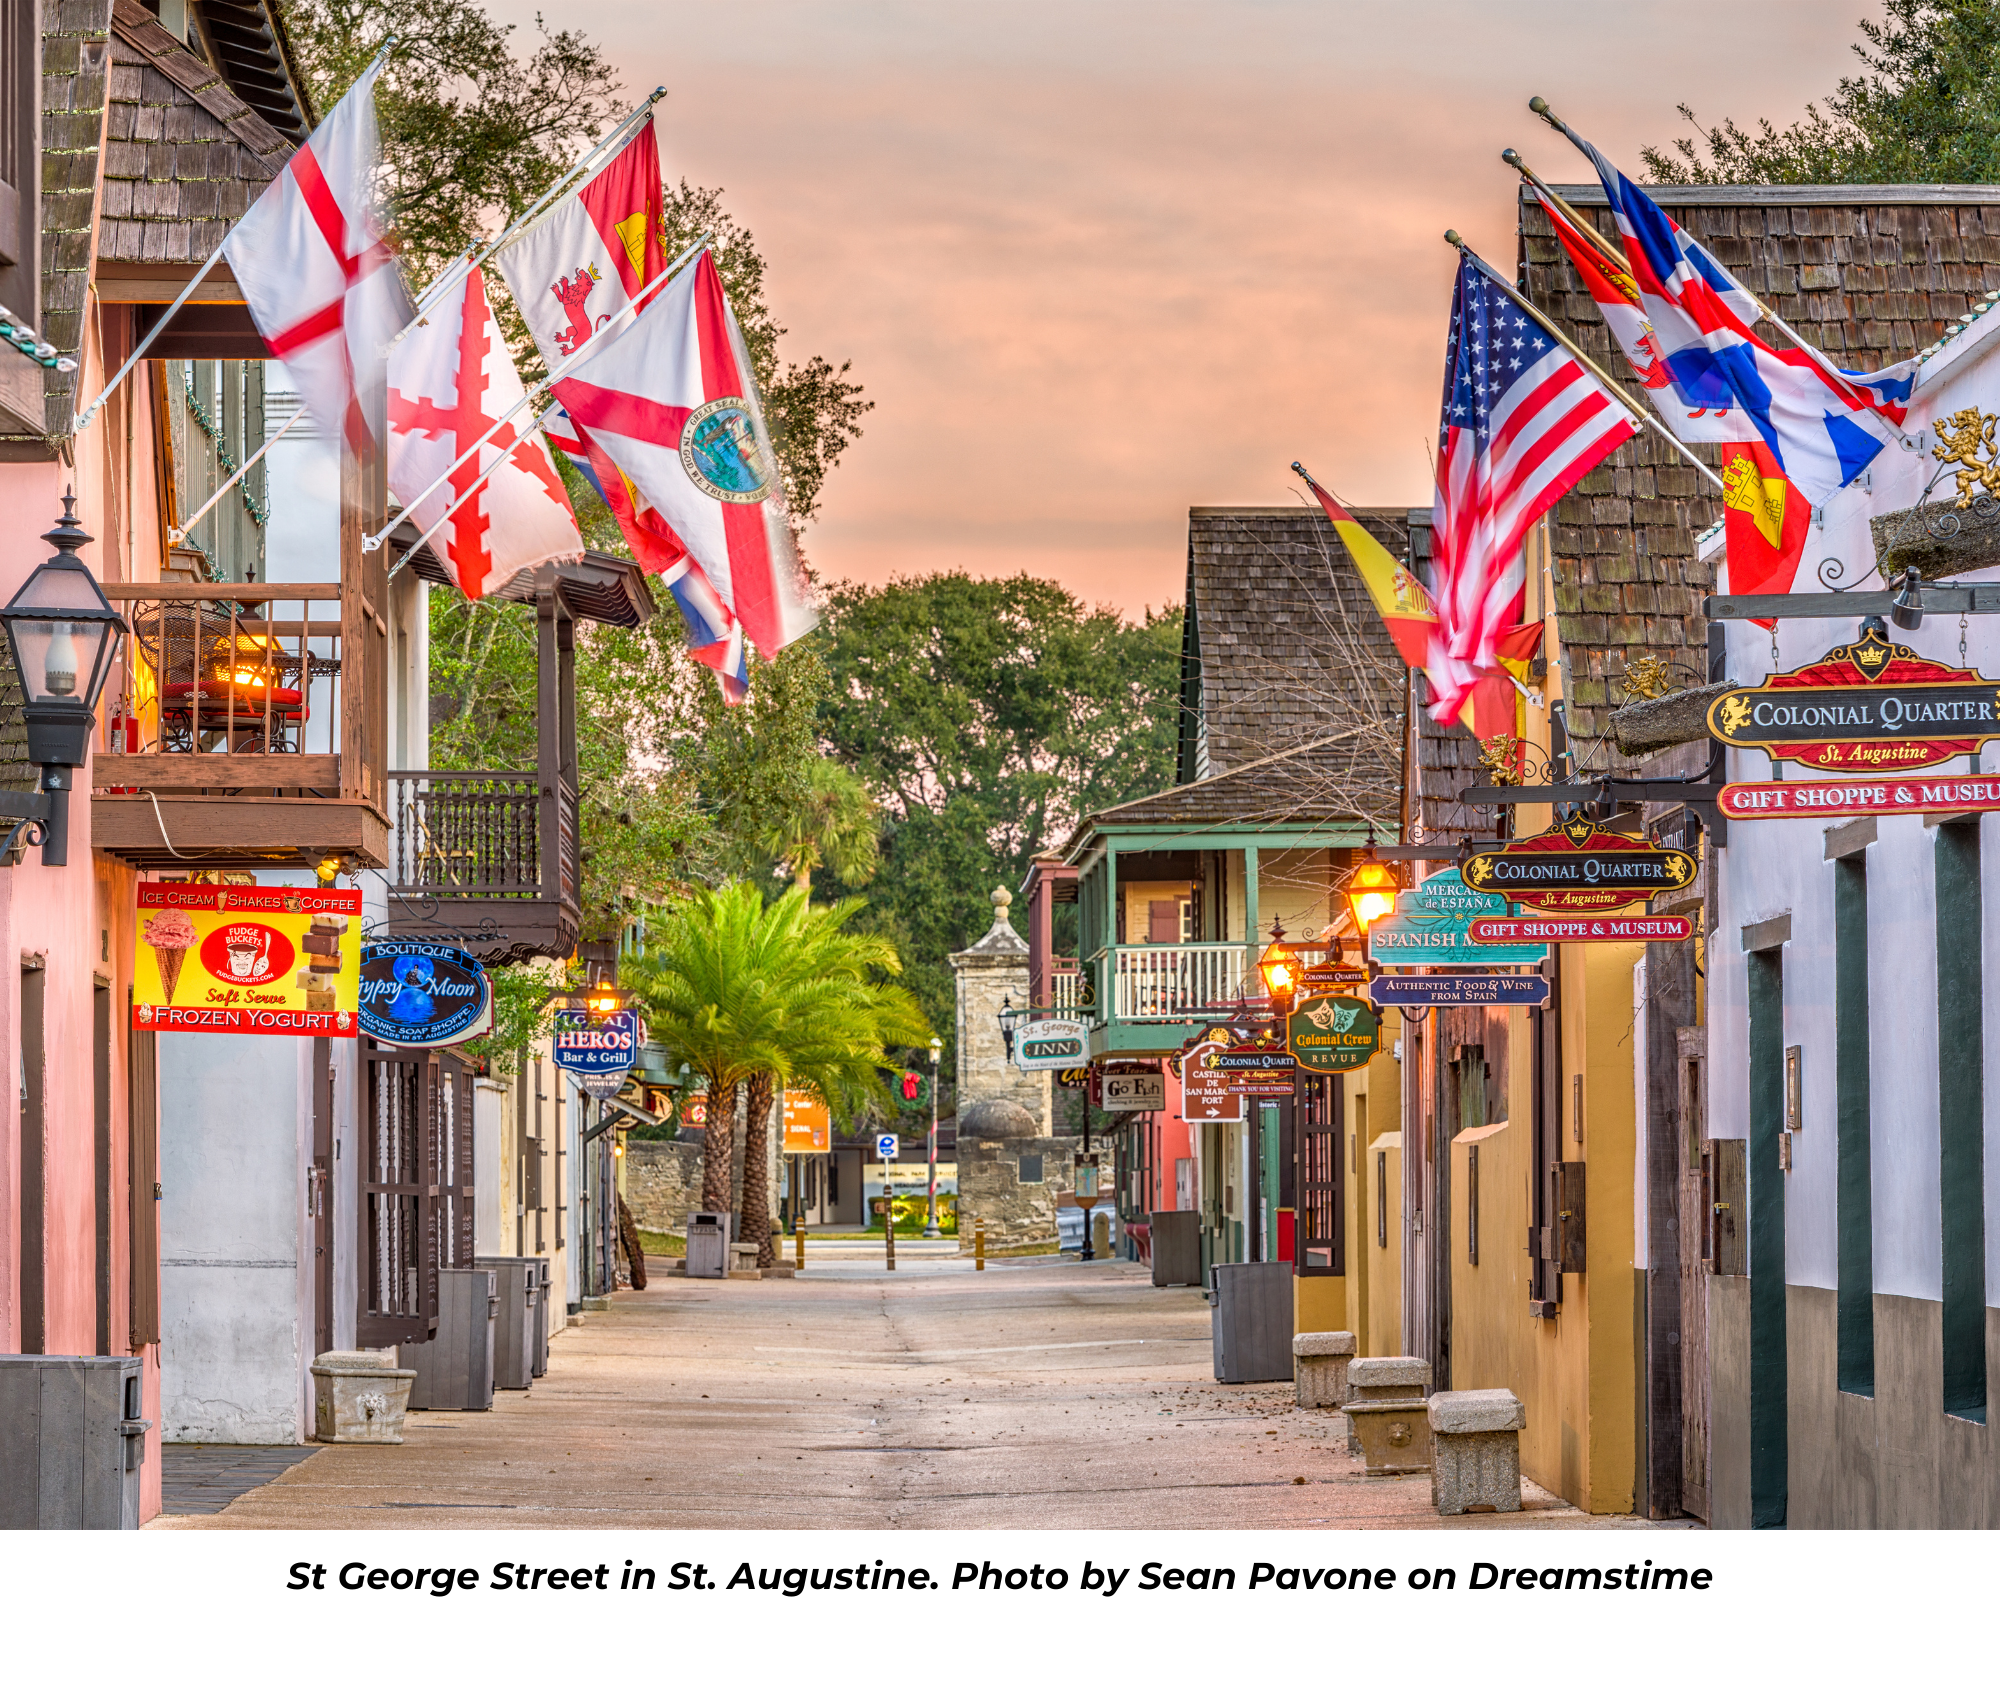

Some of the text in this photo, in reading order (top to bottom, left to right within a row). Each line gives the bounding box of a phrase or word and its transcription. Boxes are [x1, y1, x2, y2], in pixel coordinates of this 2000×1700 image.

[690, 405, 714, 426] GREAT
[715, 399, 742, 409] SEAL
[682, 436, 737, 501] IN GOD WE TRUST
[1752, 697, 1993, 731] COLONIAL QUARTER
[1818, 742, 1928, 764] St. Augustine
[1733, 782, 2000, 809] GIFT SHOPPE & MUSEU
[1494, 859, 1664, 883] COLONIAL QUARTER
[1425, 885, 1490, 896] MERCA
[142, 891, 356, 911] ICE CREAM SHAKES COFFEE
[1425, 896, 1492, 909] de ESPAÑA
[1540, 891, 1617, 907] St. Augustine
[229, 927, 259, 936] FUDGE
[1479, 922, 1683, 936] GIFT SHOPPE & MUSEUM
[225, 935, 262, 946] BUCKETS
[1375, 933, 1456, 947] SPANISH
[375, 944, 455, 959] BOUTIQUE
[216, 969, 274, 983] FUDGEBUCKETS.COM
[1334, 973, 1362, 982] QUARTER
[425, 977, 475, 997] Moon
[1386, 979, 1534, 992] AUTHENTIC FOOD & WINE
[205, 988, 287, 1006] Soft Serve
[1431, 990, 1498, 1000] FROM SPAIN
[155, 1006, 334, 1029] FROZEN YOGURT
[358, 1005, 471, 1035] ORGANIC SOAP SHOPPE
[358, 1016, 376, 1031] HAND
[377, 1026, 400, 1039] MADE
[425, 1018, 467, 1040] AUGUSTINE
[1022, 1022, 1080, 1039] St. George
[557, 1031, 632, 1050] HEROS
[1296, 1034, 1372, 1047] Colonial Crew
[1033, 1042, 1072, 1056] INN
[563, 1052, 627, 1063] Bar & Grill
[1220, 1055, 1294, 1068] COLONIAL QUARTE
[1312, 1054, 1357, 1063] REVUE
[1192, 1070, 1230, 1078] CASTILL
[1253, 1070, 1279, 1079] Augustine
[1107, 1081, 1129, 1096] Go
[1133, 1078, 1160, 1096] Fish
[1206, 1079, 1219, 1087] DE
[1185, 1088, 1229, 1096] SAN MARC
